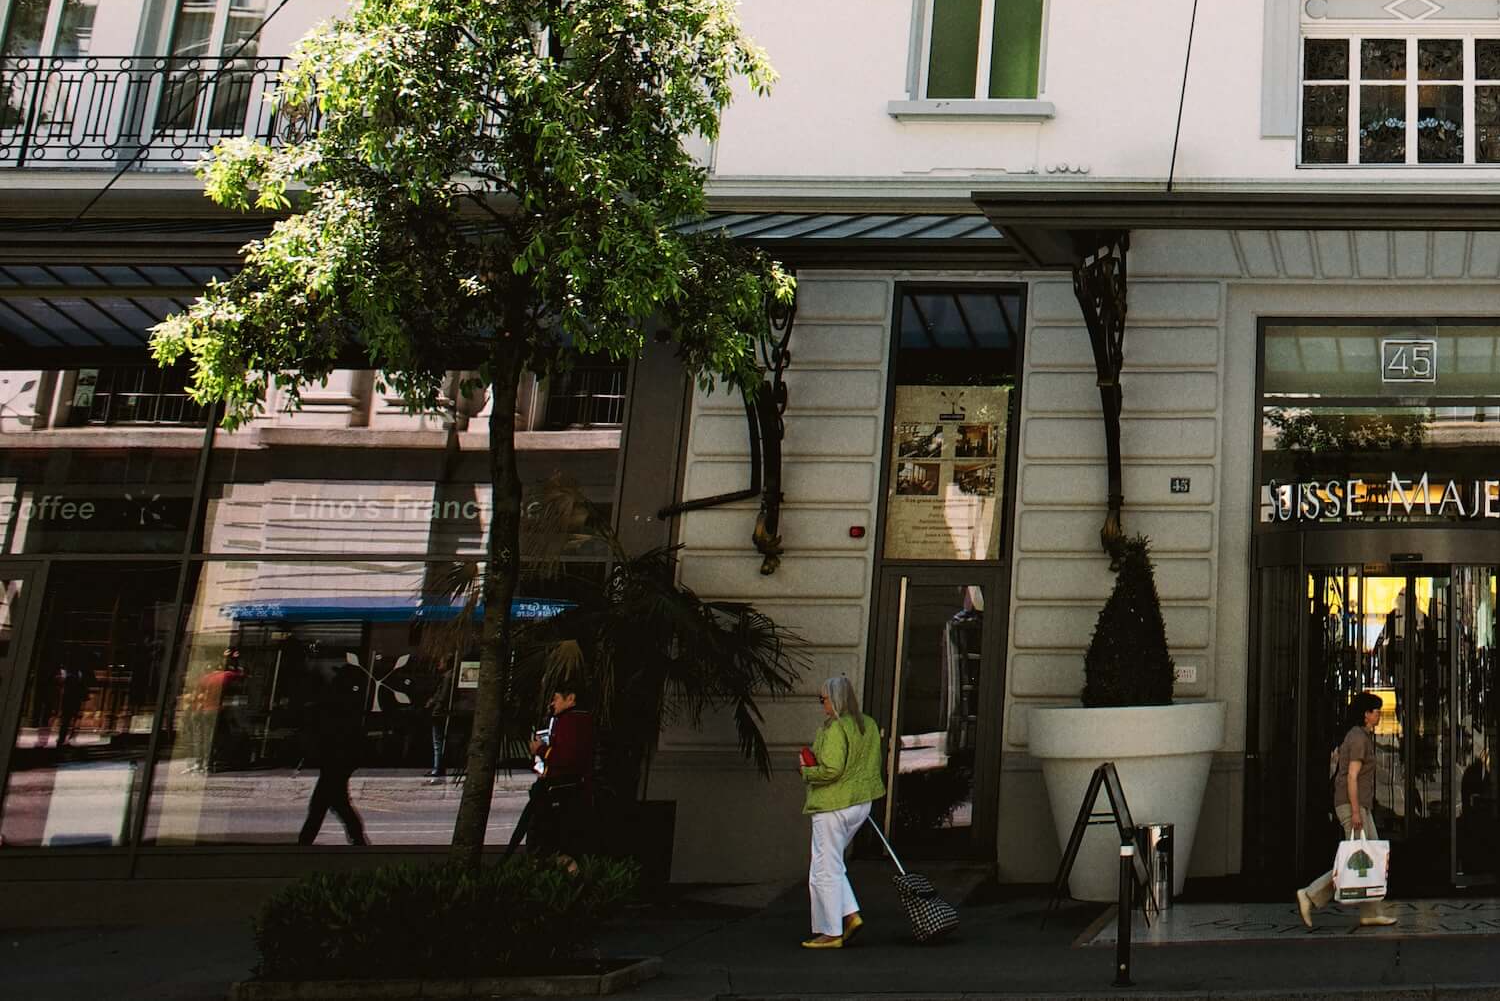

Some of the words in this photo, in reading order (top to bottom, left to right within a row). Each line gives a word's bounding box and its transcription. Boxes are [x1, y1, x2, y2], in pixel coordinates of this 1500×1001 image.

[1387, 346, 1431, 376] 45
[289, 494, 381, 520] Lino's
[1268, 479, 1364, 523] SUISSE
